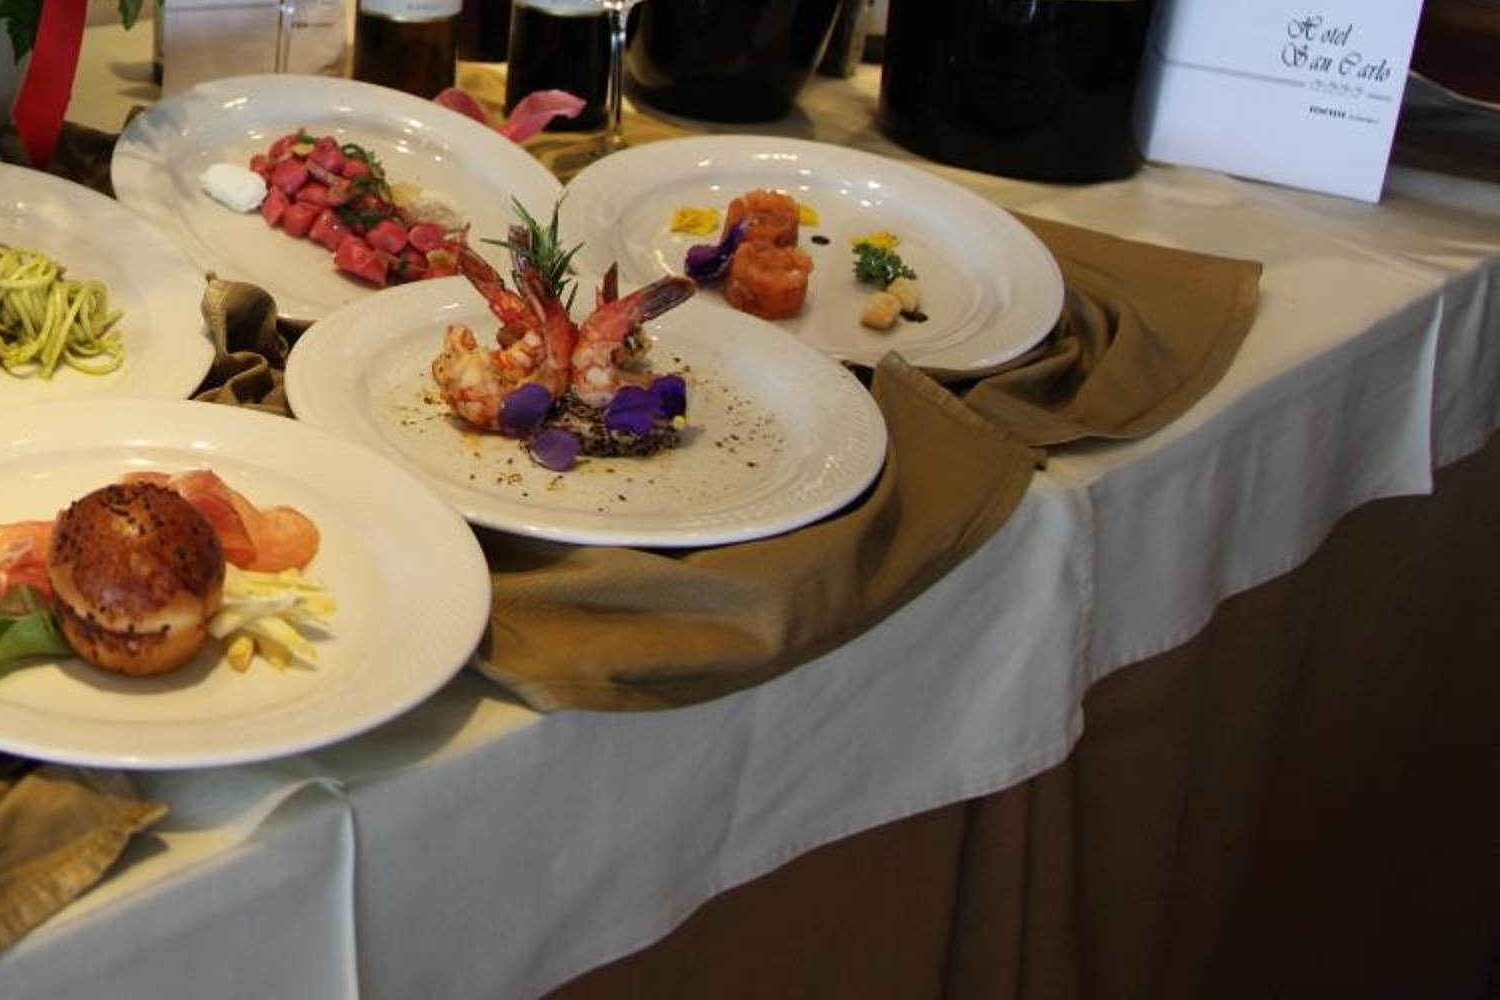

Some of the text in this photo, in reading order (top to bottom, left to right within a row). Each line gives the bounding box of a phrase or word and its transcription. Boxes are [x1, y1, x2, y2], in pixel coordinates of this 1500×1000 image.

[1287, 15, 1353, 47] Hotel
[1280, 42, 1391, 83] San Carlo
